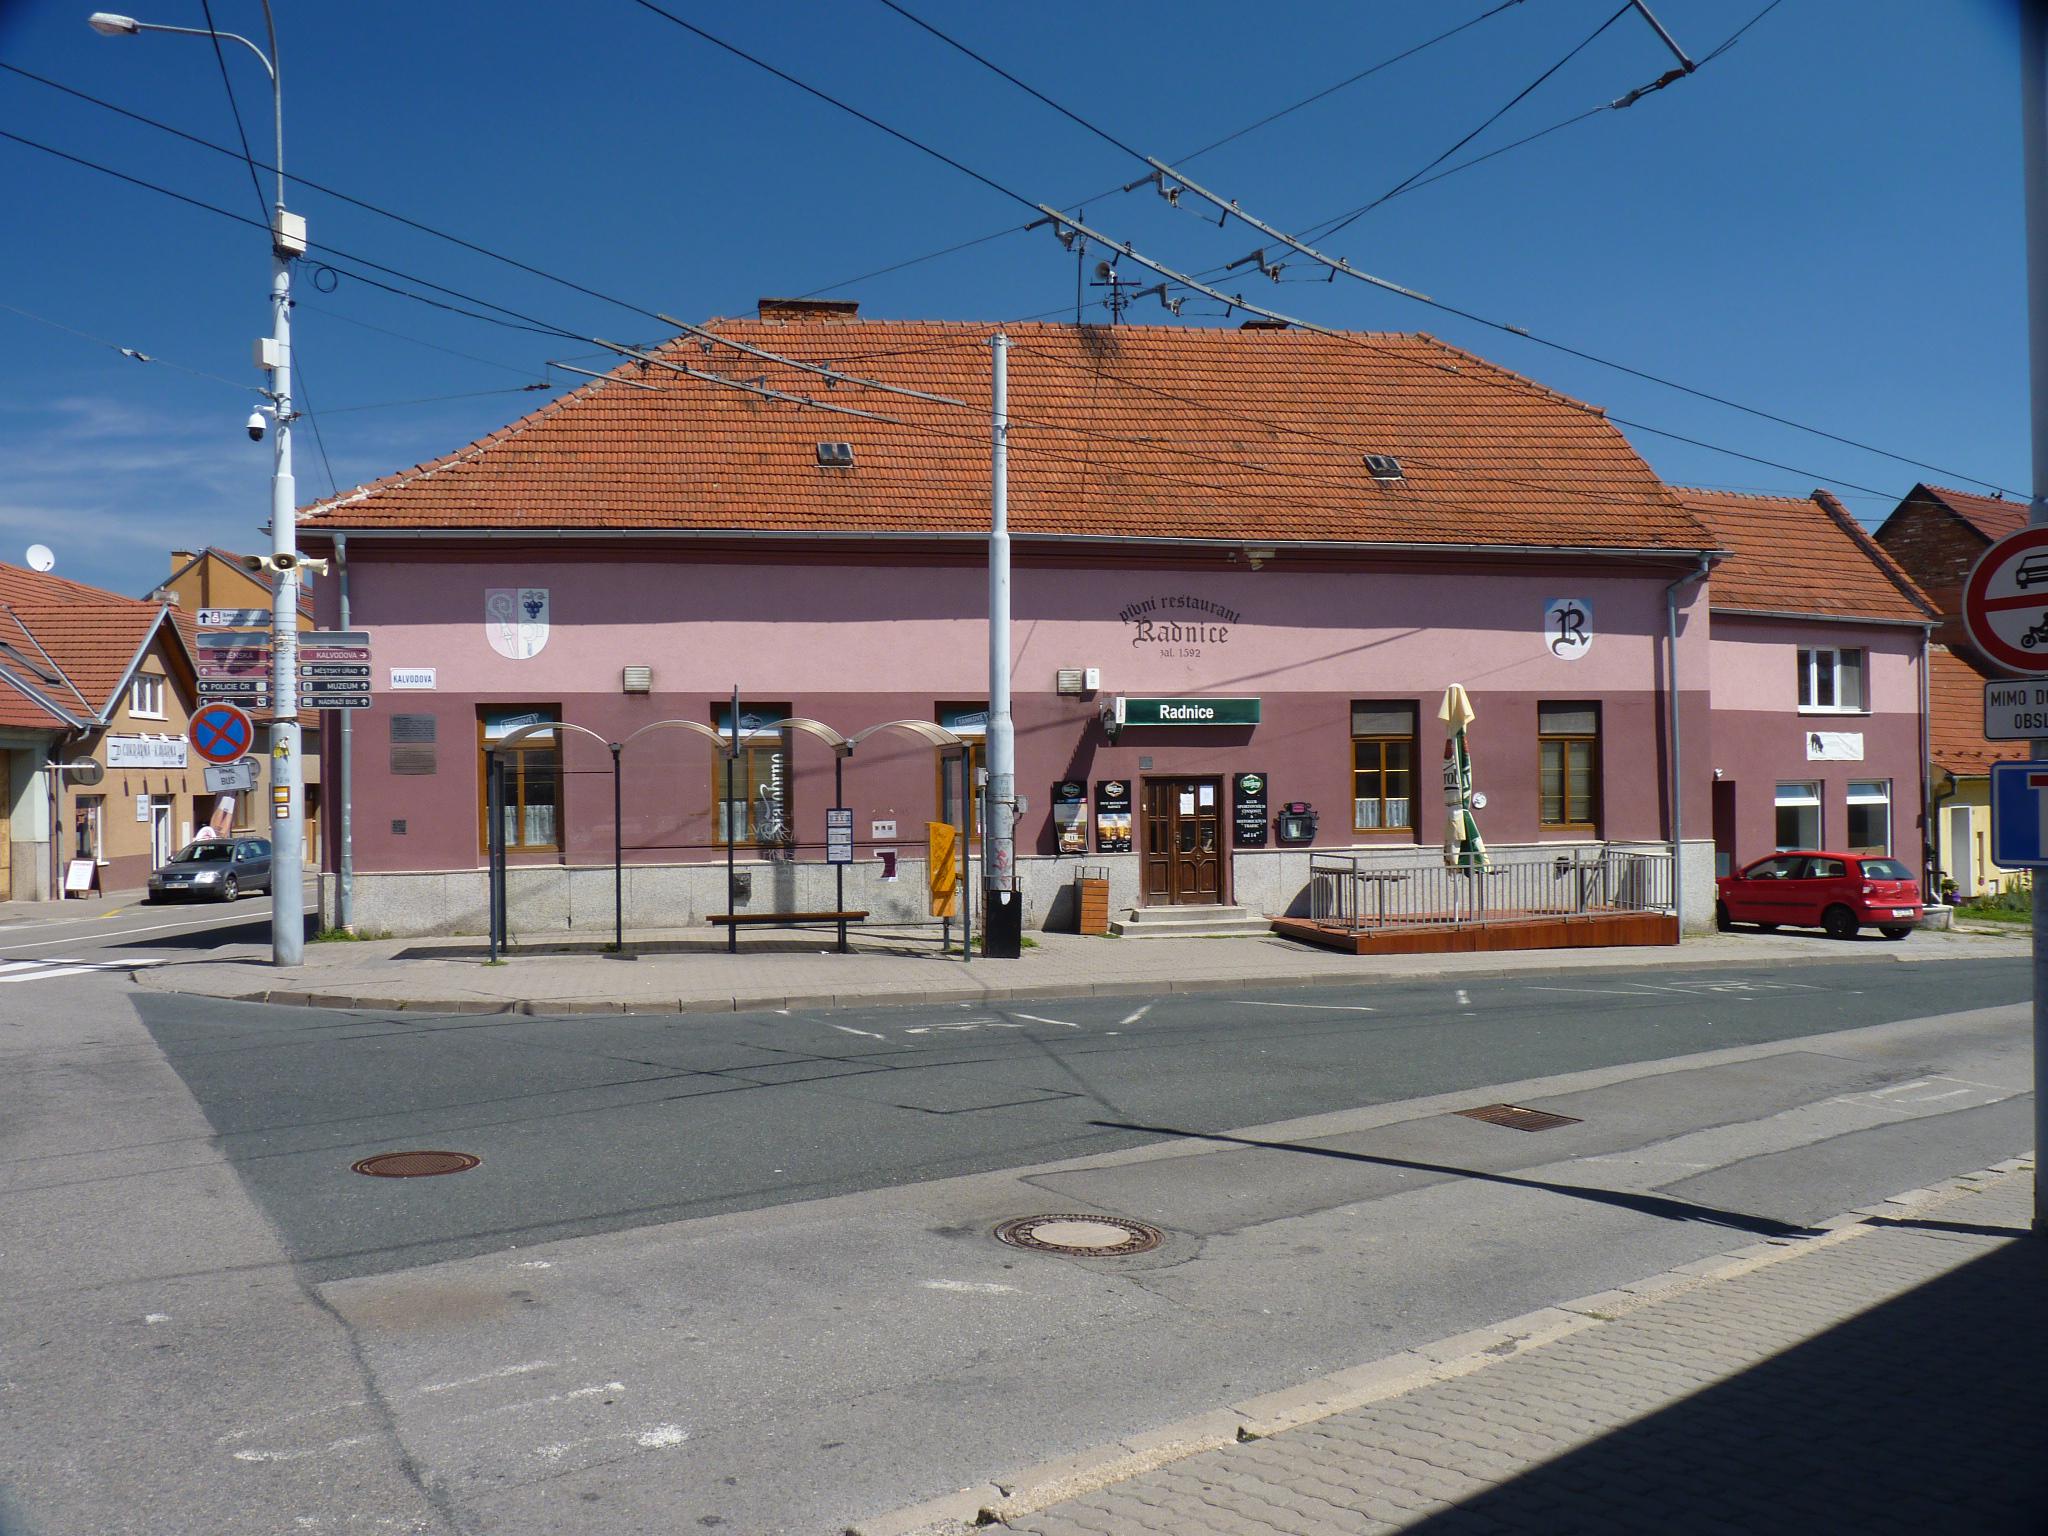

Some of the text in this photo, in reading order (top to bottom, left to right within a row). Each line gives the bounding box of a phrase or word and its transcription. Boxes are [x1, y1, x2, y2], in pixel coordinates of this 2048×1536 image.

[1160, 594, 1241, 625] restaurant
[1132, 616, 1229, 649] Radnice
[1551, 601, 1590, 657] R
[316, 651, 357, 659] KALVODOVA
[1179, 648, 1201, 658] 1592
[393, 674, 433, 683] KALVODOVA
[327, 682, 359, 690] MUZEUM
[1991, 689, 2048, 706] MIMO D
[1159, 704, 1214, 719] Radnice
[221, 776, 236, 785] BUS
